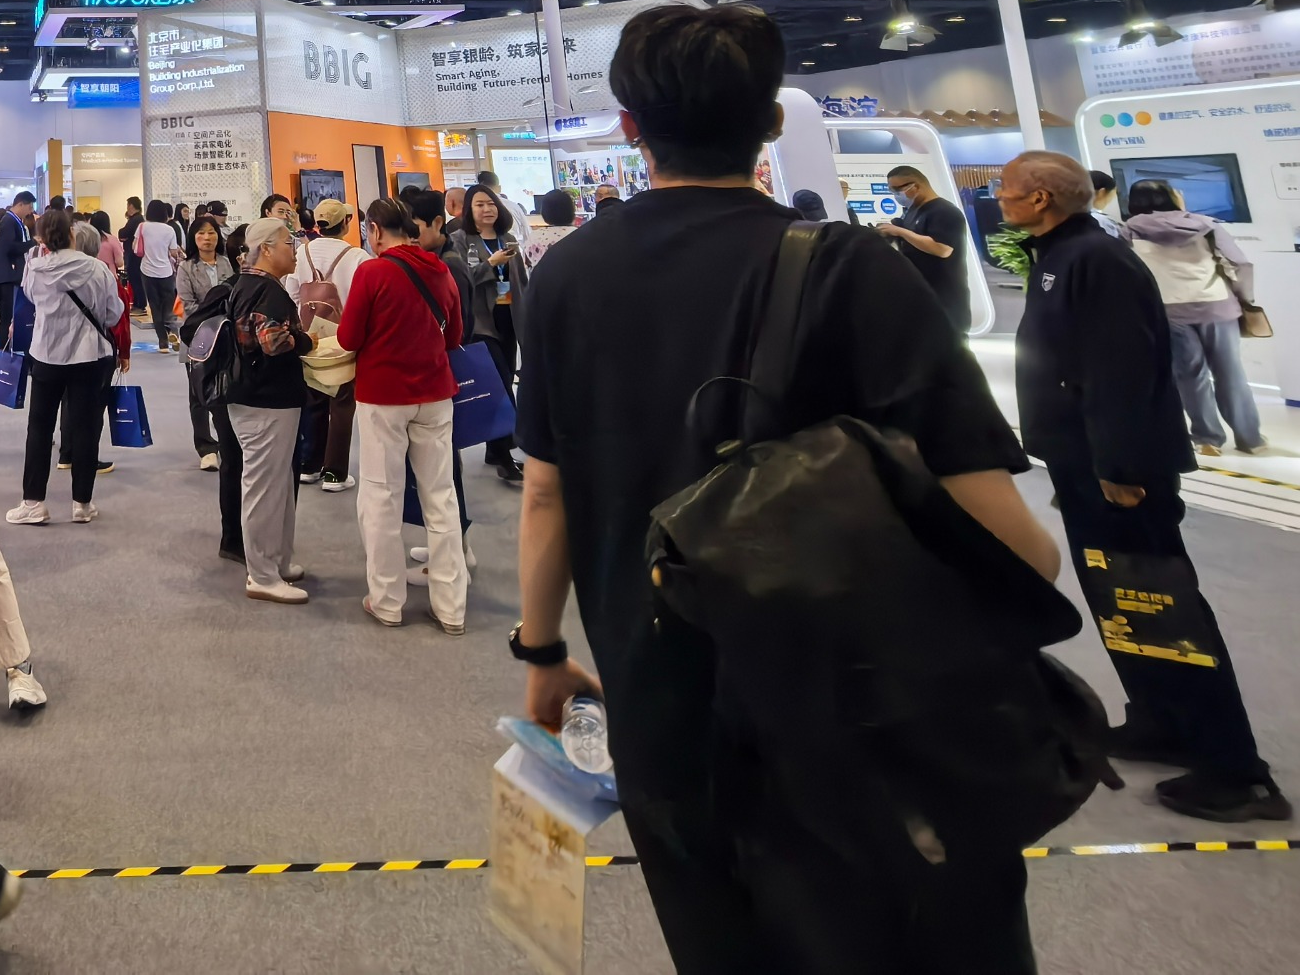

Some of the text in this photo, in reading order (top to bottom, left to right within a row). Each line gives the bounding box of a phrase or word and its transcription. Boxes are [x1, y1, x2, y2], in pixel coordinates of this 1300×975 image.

[148, 61, 175, 71] Beijing
[303, 39, 372, 90] BBIG
[149, 63, 245, 82] Building Industrialization
[435, 72, 465, 81] Smart
[437, 81, 477, 92] Building
[566, 70, 603, 81] Homes
[80, 83, 120, 93] 智享朝阳
[150, 84, 175, 94] Group
[161, 116, 194, 129] BBIG
